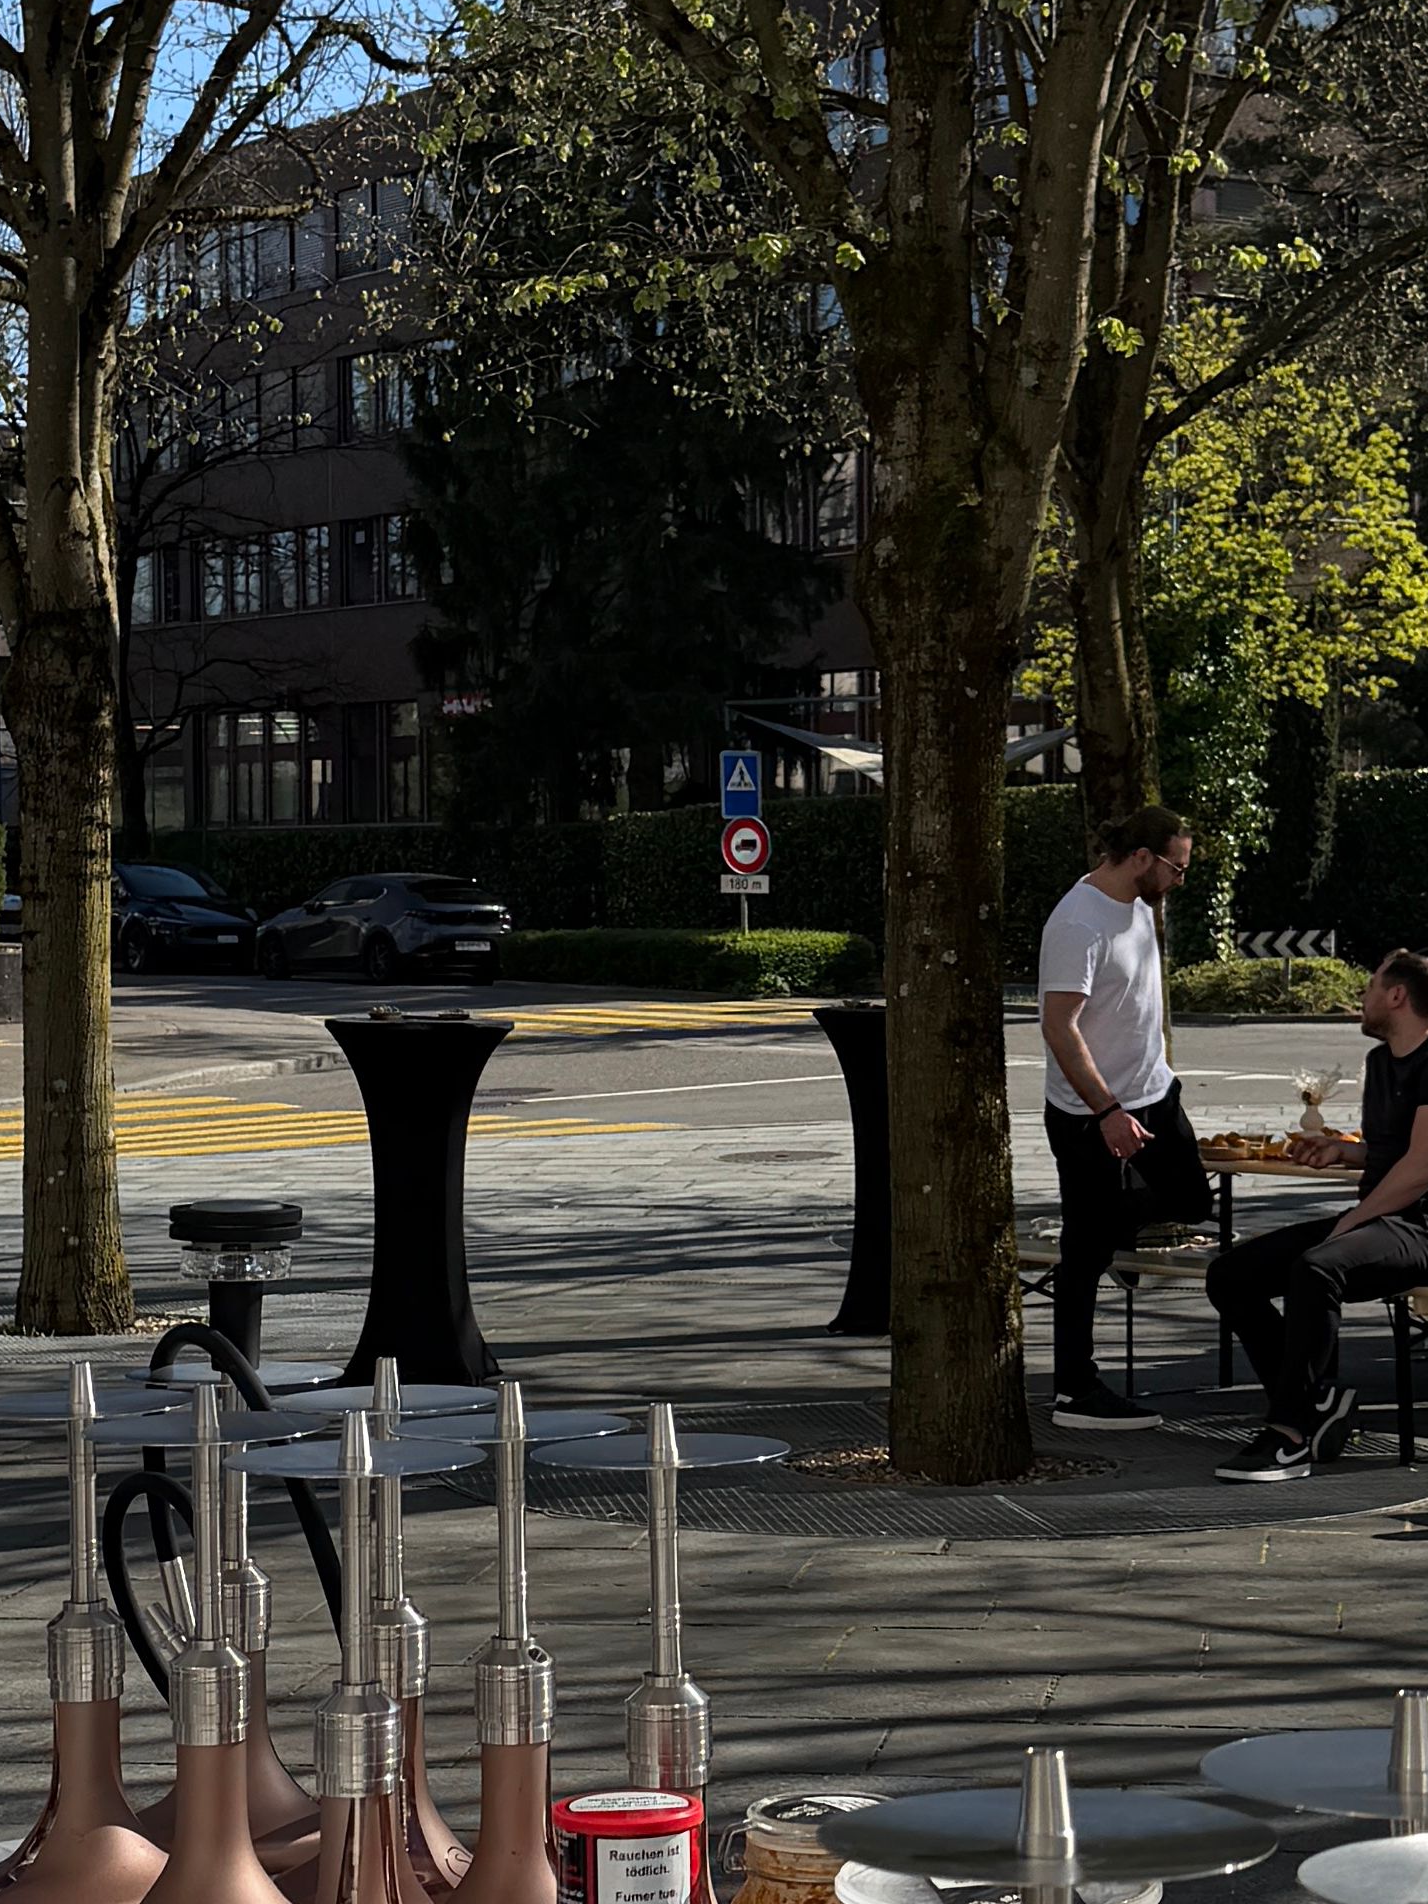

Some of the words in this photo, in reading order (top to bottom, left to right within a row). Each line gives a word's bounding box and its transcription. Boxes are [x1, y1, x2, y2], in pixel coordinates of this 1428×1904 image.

[729, 878, 749, 890] 180
[751, 880, 762, 890] m
[609, 1849, 663, 1861] Rauchen
[668, 1845, 680, 1857] ist
[626, 1865, 670, 1878] tödlich.
[616, 1891, 656, 1903] Fumer
